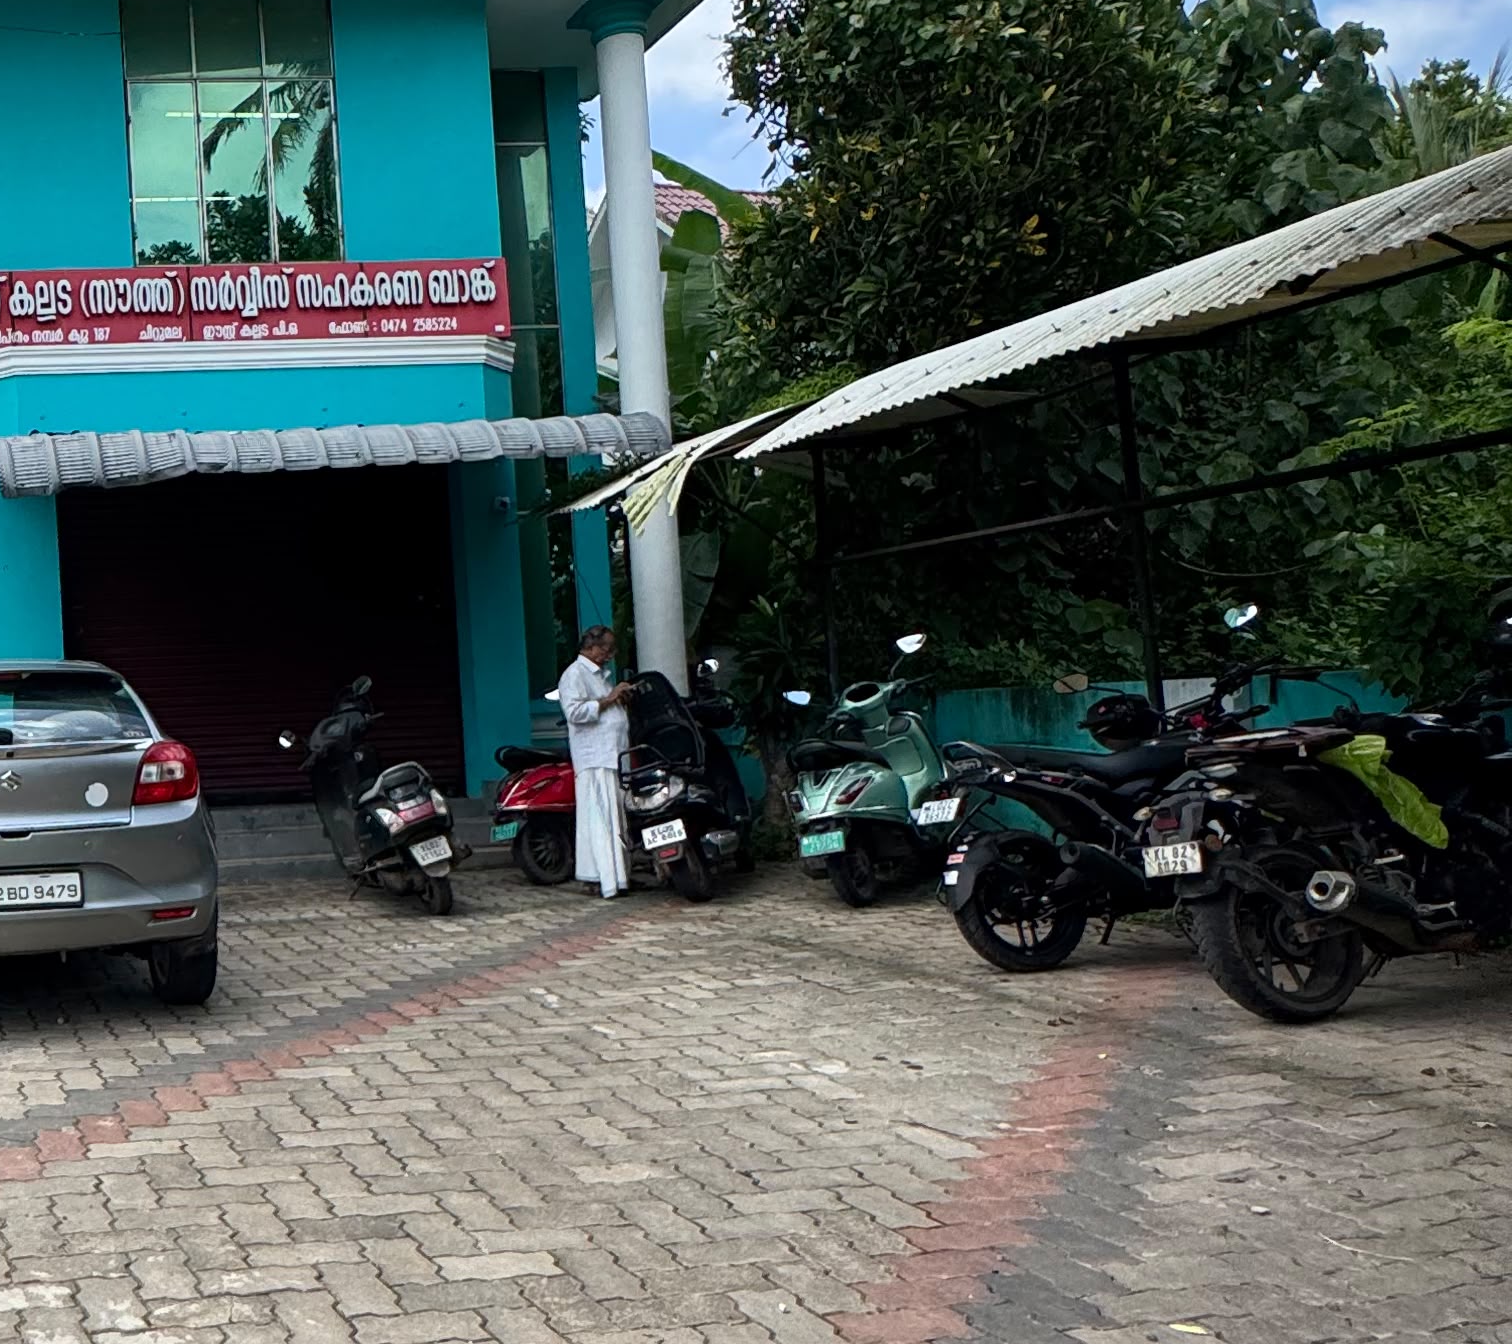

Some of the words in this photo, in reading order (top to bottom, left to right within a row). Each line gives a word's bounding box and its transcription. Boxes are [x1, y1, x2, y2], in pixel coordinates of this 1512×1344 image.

[9, 279, 72, 322] കല്ലട
[296, 271, 423, 311] സഹകരണ
[428, 260, 496, 304] ബാങ്ക്
[380, 318, 407, 332] 0474
[93, 327, 111, 341] 187
[34, 884, 78, 899] 9479
